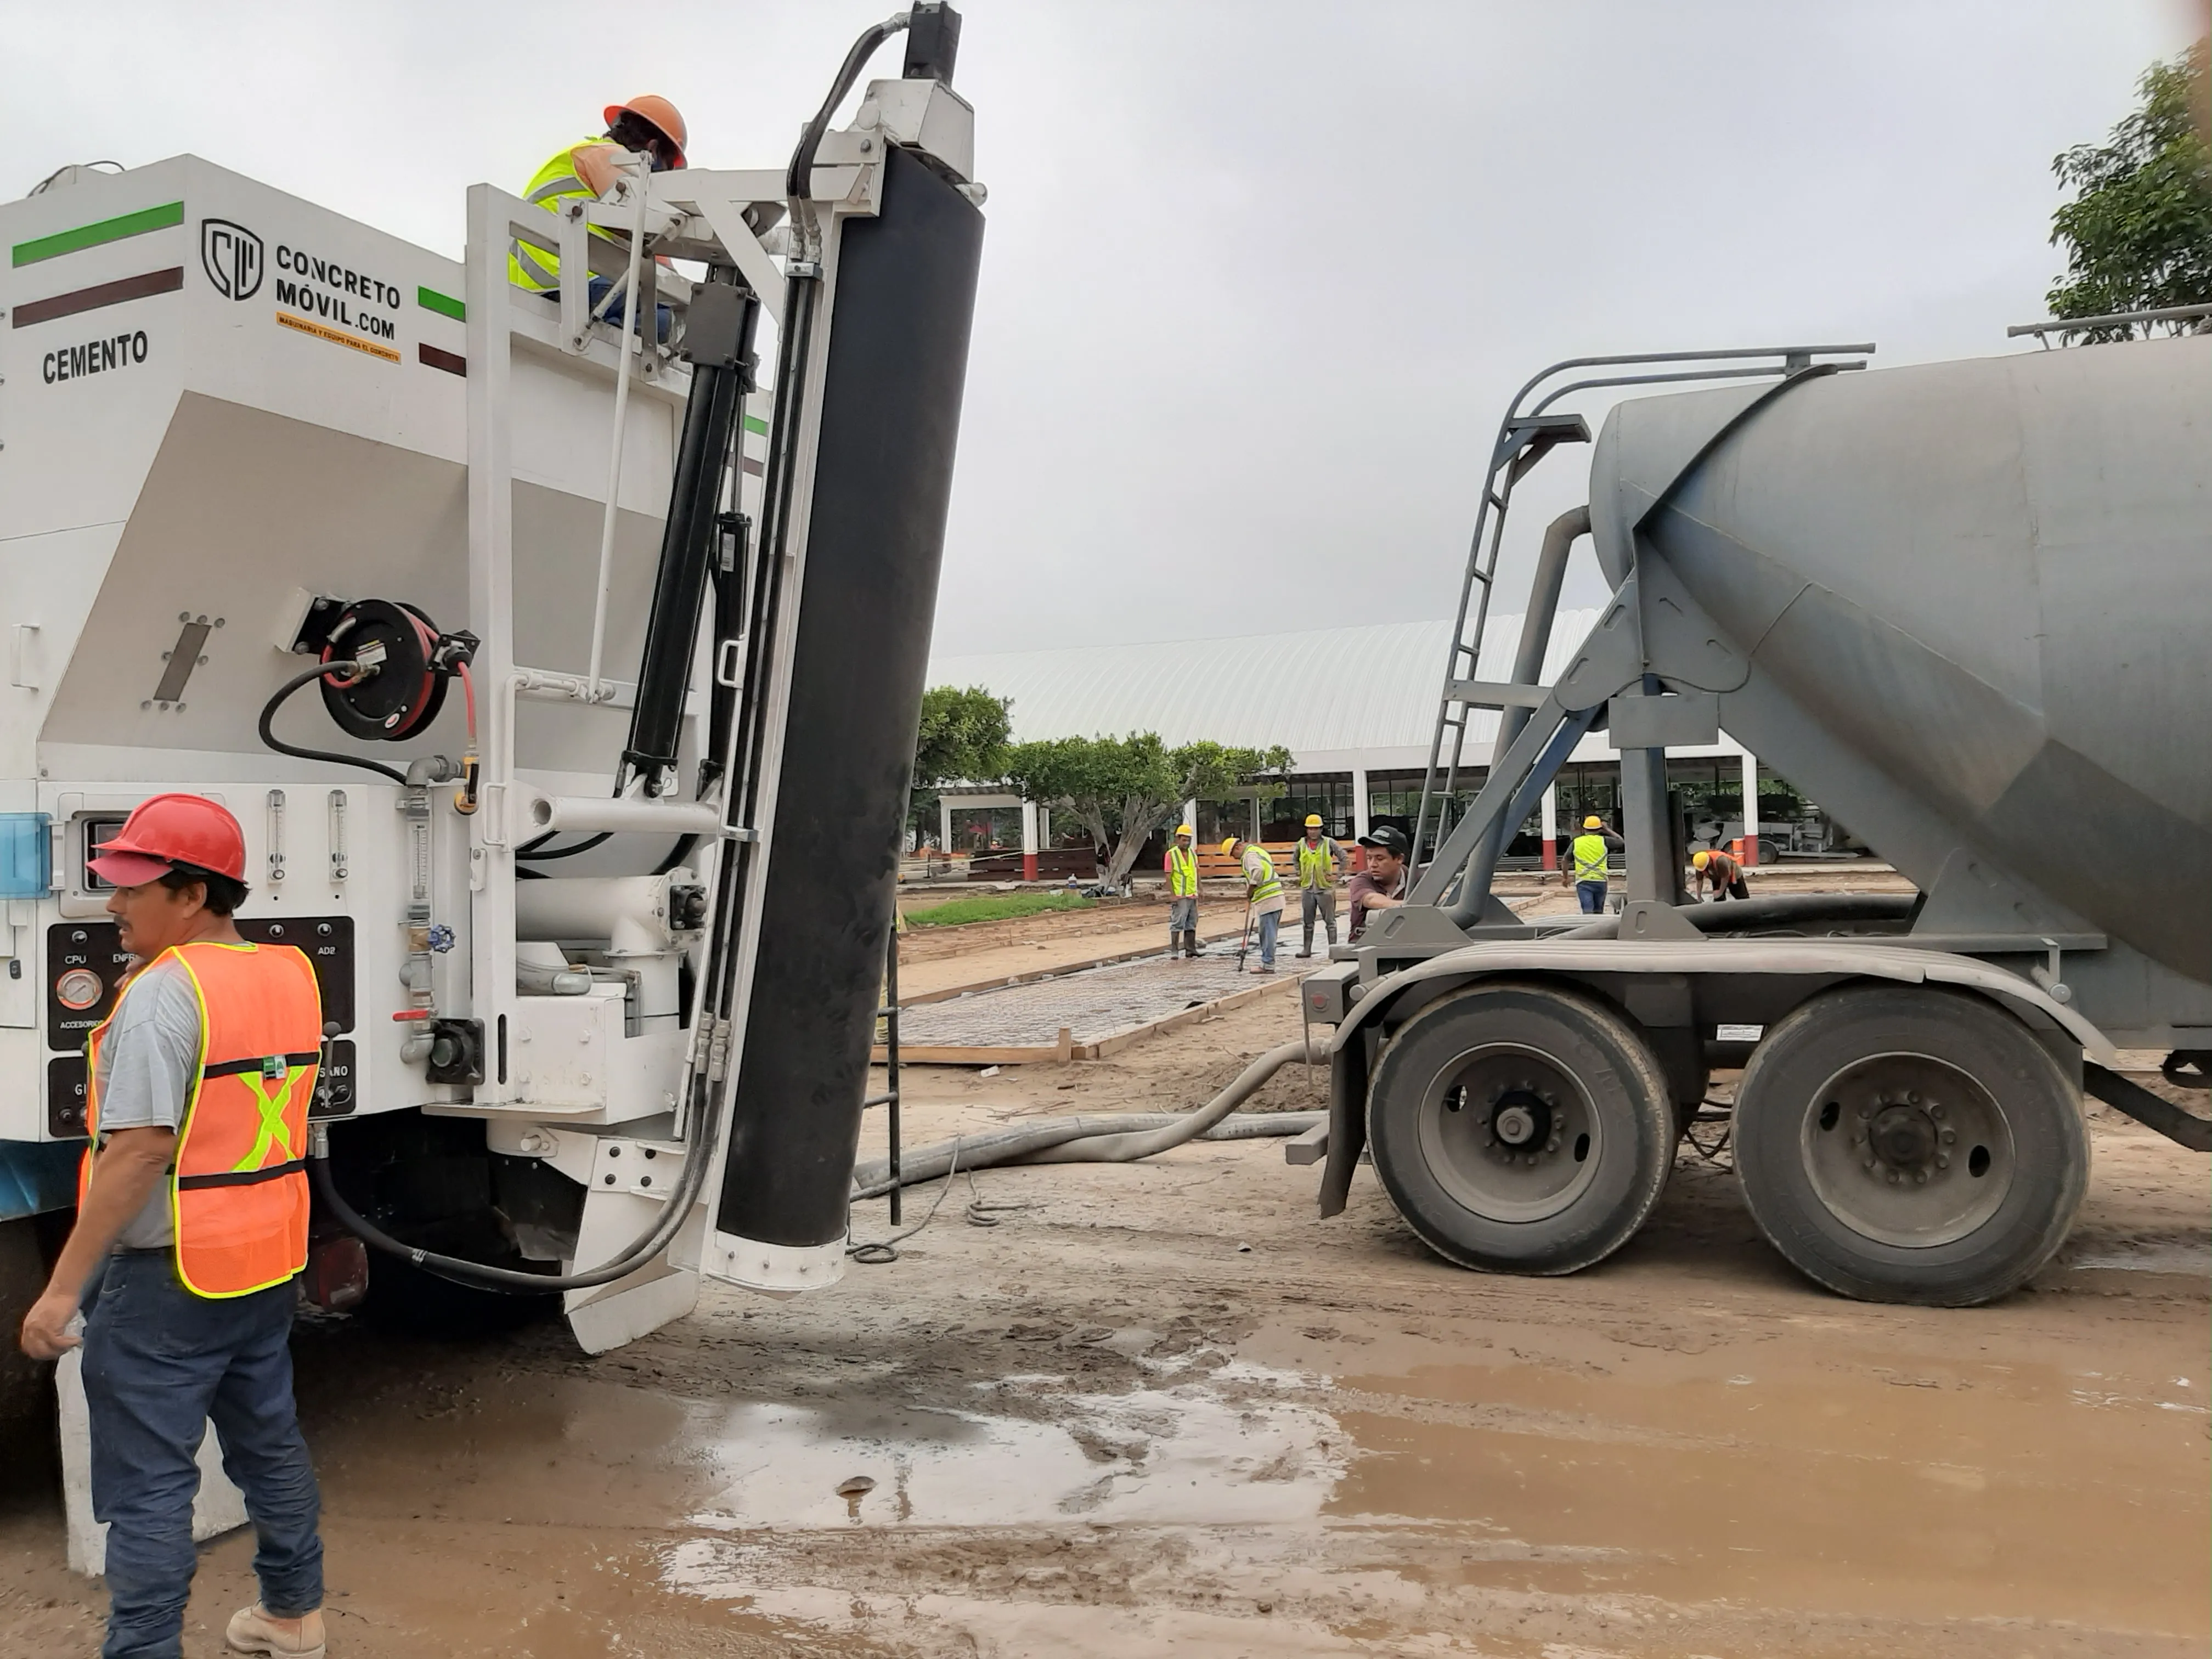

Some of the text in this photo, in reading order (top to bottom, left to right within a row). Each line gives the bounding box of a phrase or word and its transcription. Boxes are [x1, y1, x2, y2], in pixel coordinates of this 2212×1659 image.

[276, 245, 401, 309] CONCRETO
[43, 330, 148, 384] CEMENTO
[279, 316, 317, 334] MAQUINARIA
[324, 331, 345, 343] EQUIPO
[346, 339, 360, 349] PARA
[362, 343, 369, 352] EL
[370, 347, 399, 362] CONCRETO
[65, 955, 87, 964] CPU
[113, 953, 137, 963] ENFR
